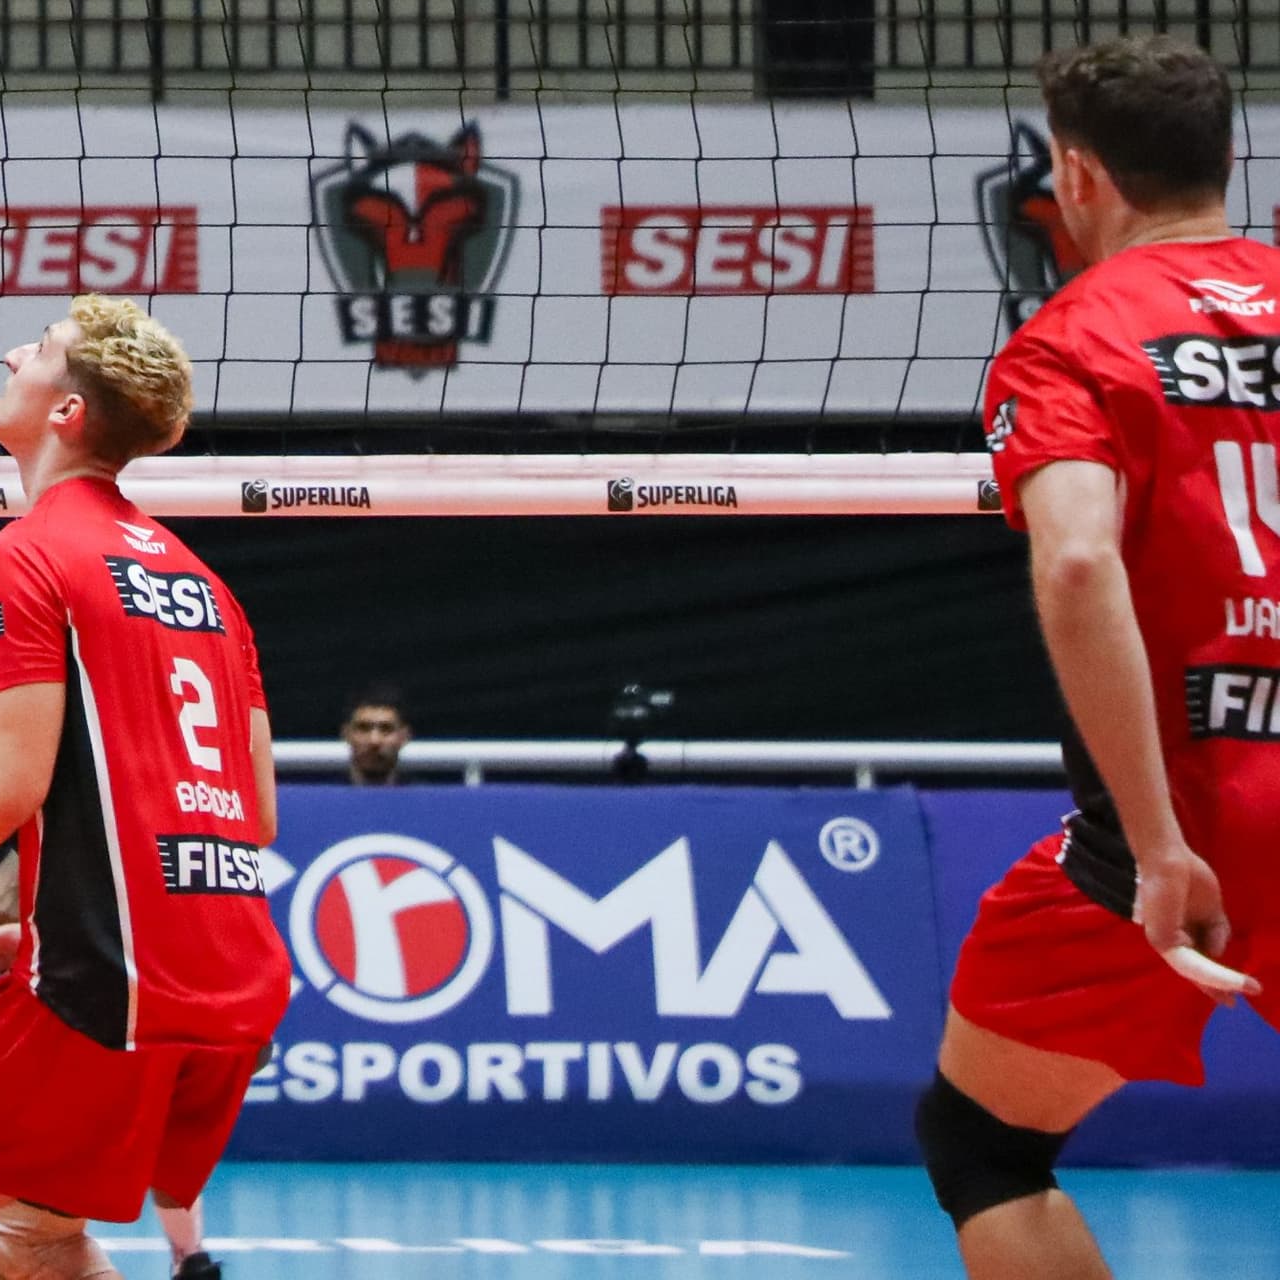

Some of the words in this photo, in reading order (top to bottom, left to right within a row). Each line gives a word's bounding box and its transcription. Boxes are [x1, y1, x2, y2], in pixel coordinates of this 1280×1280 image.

[625, 216, 850, 288] SESI
[349, 296, 483, 337] SESI
[1173, 339, 1280, 405] SE
[272, 488, 371, 510] SUPERLIGA
[638, 487, 737, 509] SUPERLIGA
[127, 563, 217, 628] SESI
[170, 657, 222, 772] 2
